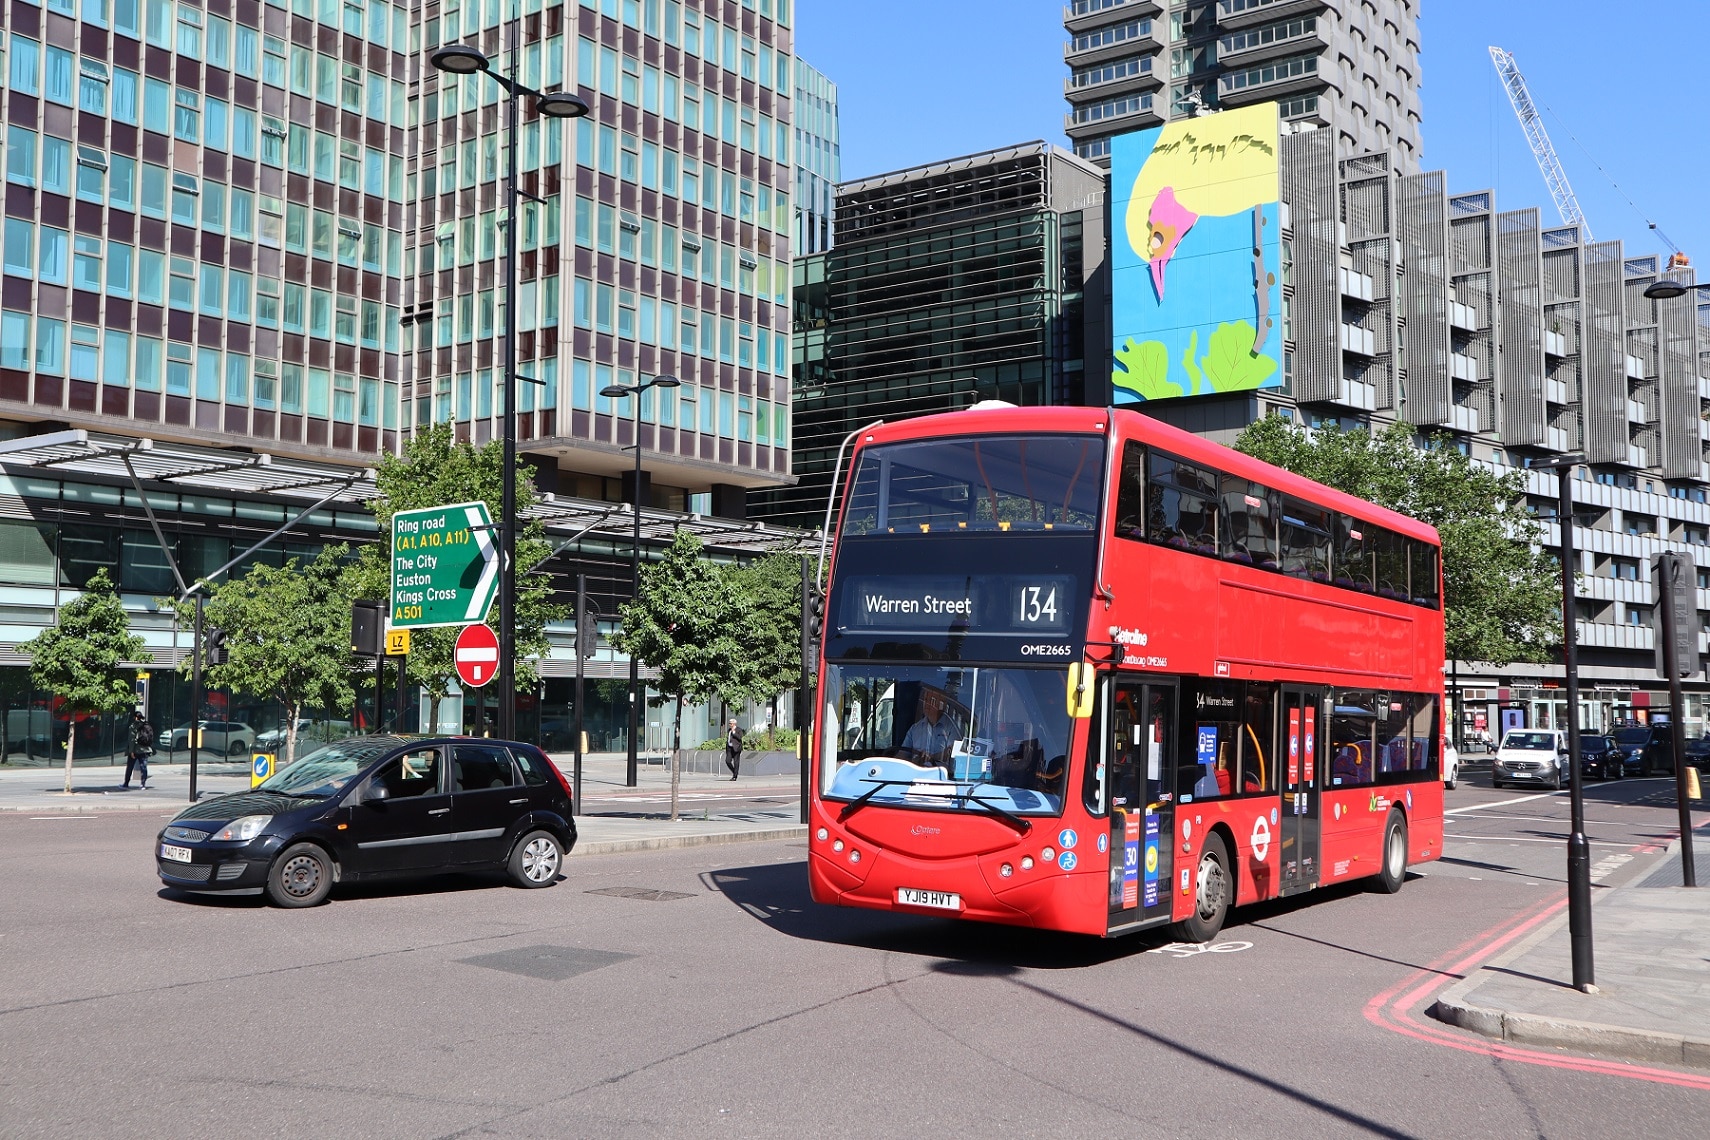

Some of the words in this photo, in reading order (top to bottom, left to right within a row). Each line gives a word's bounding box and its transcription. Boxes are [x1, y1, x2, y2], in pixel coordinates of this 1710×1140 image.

[398, 520, 418, 533] Ring
[422, 515, 445, 528] road
[445, 528, 469, 544] A11)
[396, 557, 413, 570] The
[416, 555, 437, 570] City
[396, 573, 431, 587] Euston
[396, 589, 423, 605] Kings
[427, 587, 456, 601] Cross
[1020, 586, 1057, 622] 134
[395, 606, 422, 619] A501
[865, 595, 919, 614] Warren
[924, 595, 972, 614] Street
[1021, 645, 1071, 656] OME2665
[1206, 696, 1221, 706] Warren
[1222, 697, 1234, 706] Street
[1126, 847, 1136, 866] 30
[905, 890, 928, 904] YJ19
[930, 892, 952, 906] HVT
